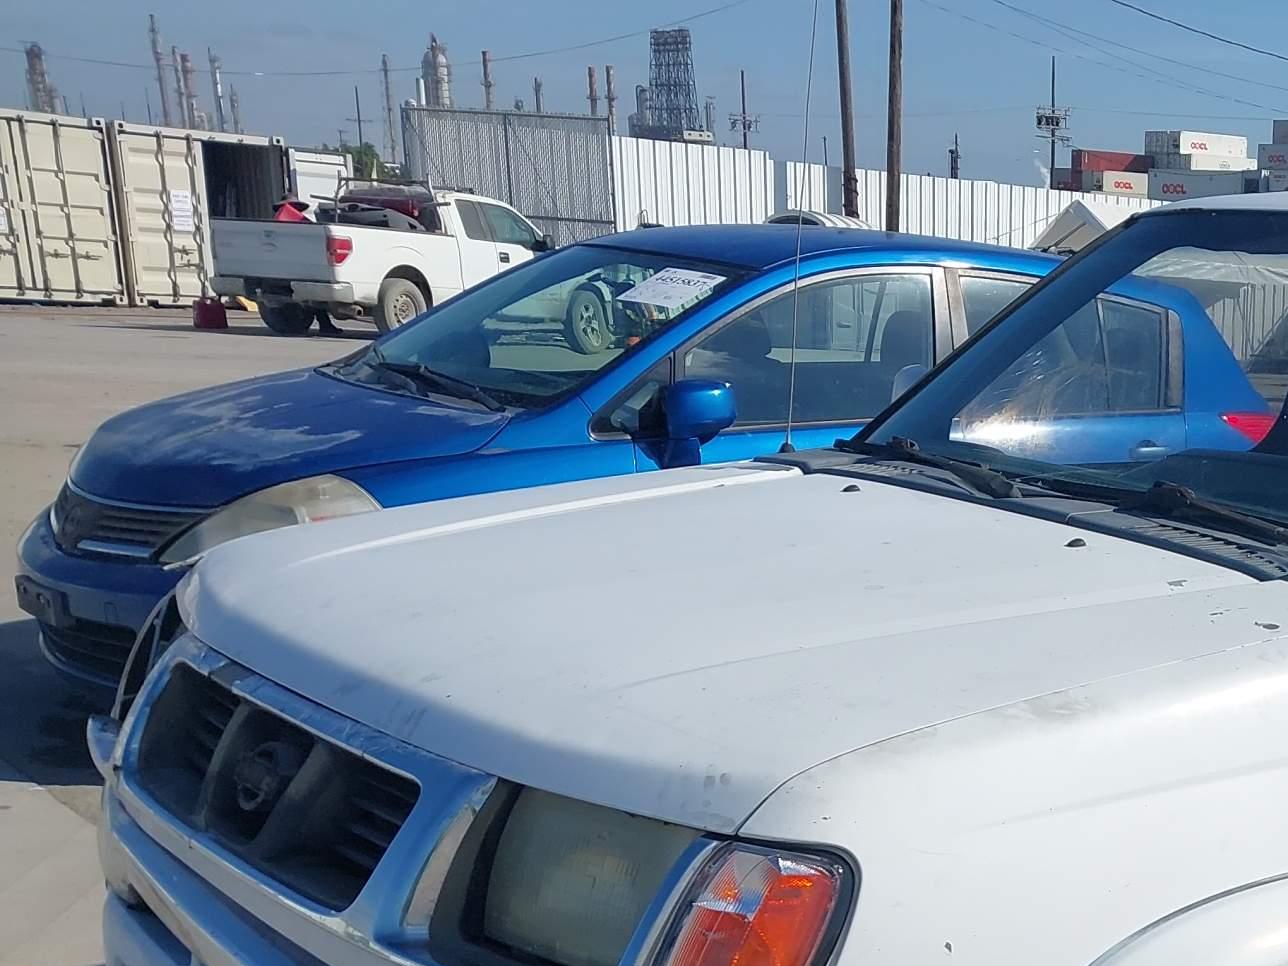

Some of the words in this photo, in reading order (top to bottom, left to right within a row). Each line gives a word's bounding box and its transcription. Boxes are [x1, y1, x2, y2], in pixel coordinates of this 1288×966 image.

[1190, 142, 1208, 151] OOCL
[1114, 181, 1133, 190] OOCL
[1162, 183, 1187, 194] OOCL
